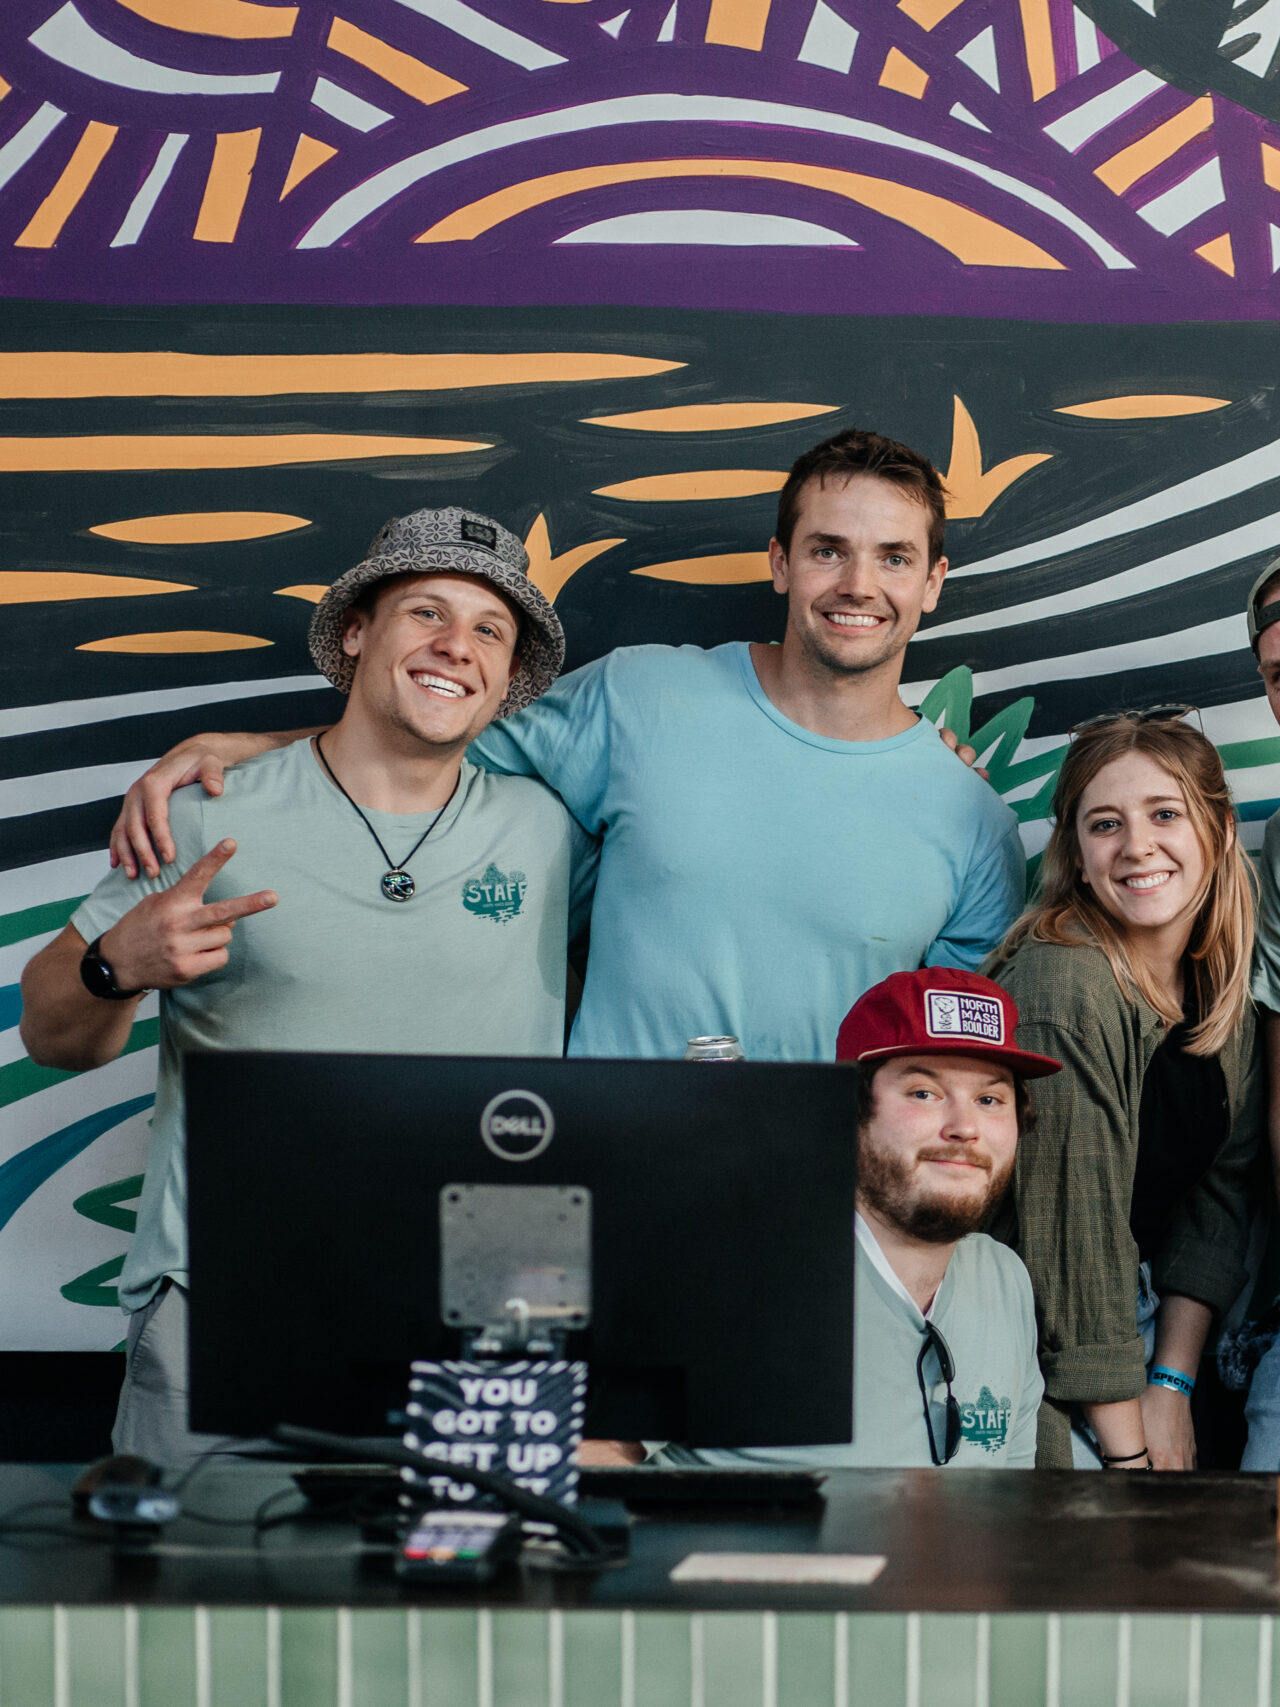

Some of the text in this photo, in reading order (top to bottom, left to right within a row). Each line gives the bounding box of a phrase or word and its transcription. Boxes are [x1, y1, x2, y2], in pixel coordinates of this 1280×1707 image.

[466, 882, 528, 903] STAFF
[960, 998, 998, 1014] NORTH
[961, 1010, 999, 1025] MASS
[962, 1021, 999, 1039] BOULDER
[490, 1115, 544, 1136] DELL
[458, 1378, 538, 1406] YOU
[431, 1409, 558, 1436] GOT TO
[962, 1408, 1012, 1429] STAFF
[422, 1441, 563, 1473] GET UP
